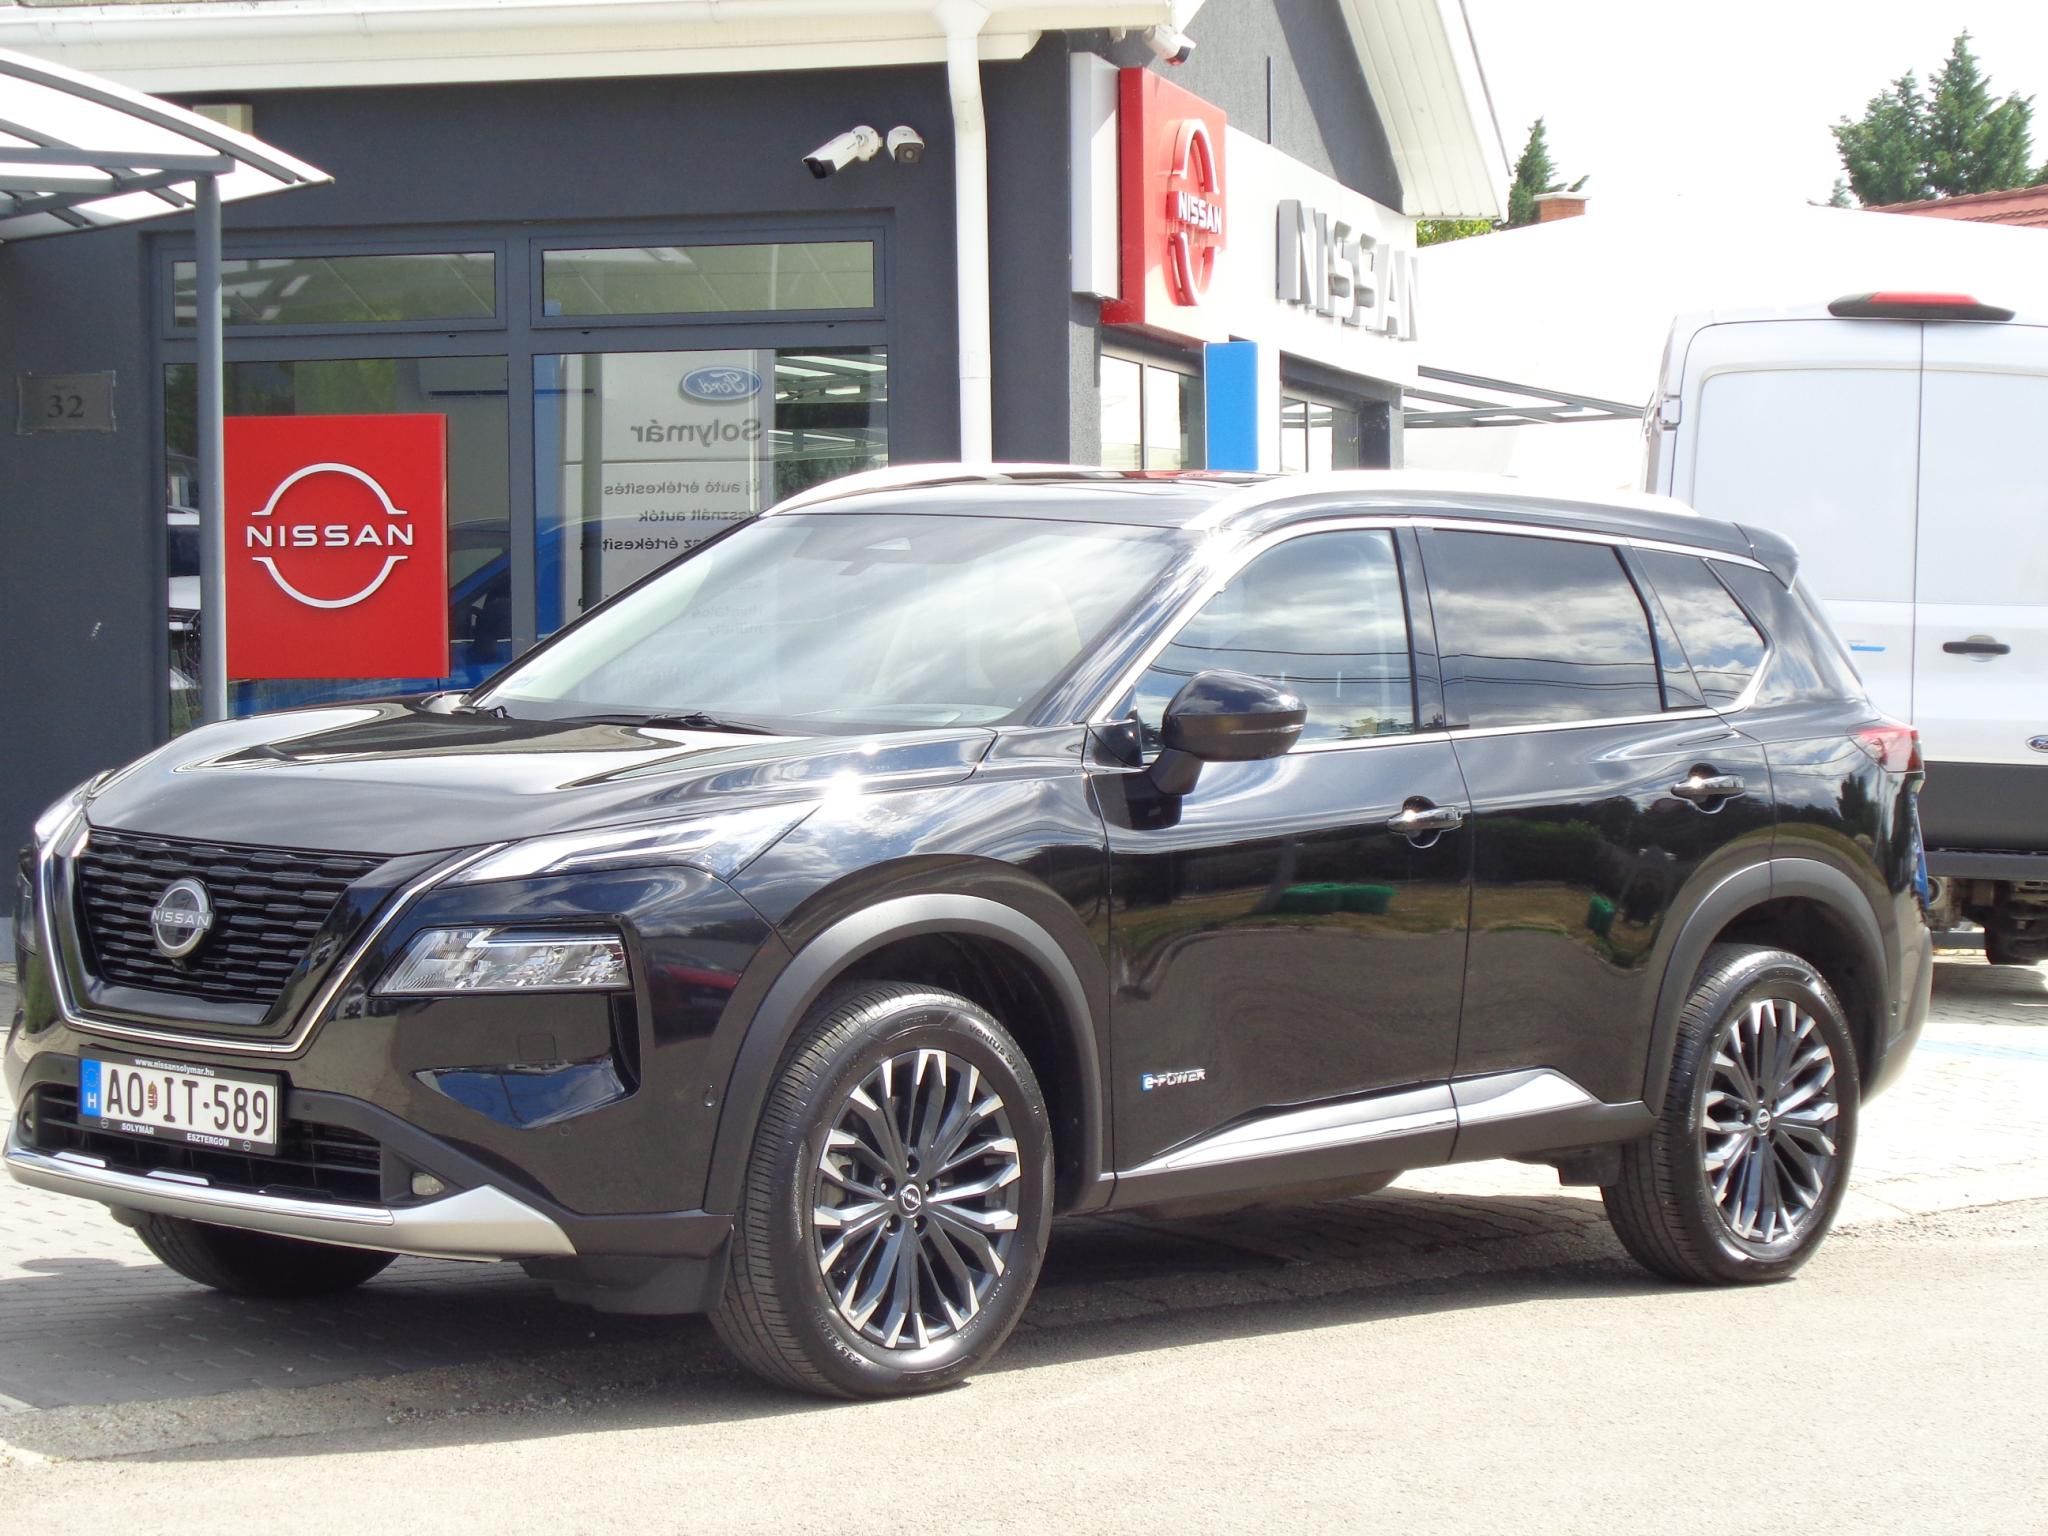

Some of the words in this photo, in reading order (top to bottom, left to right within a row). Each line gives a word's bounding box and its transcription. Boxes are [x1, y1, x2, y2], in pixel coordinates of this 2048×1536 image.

[1176, 191, 1222, 236] NISSAN
[1277, 199, 1418, 342] NISSAN
[47, 395, 85, 418] 32
[247, 523, 414, 547] NISSAN
[151, 909, 210, 927] NISSAN
[134, 1058, 215, 1077] www.nissansolymar.hu
[87, 1093, 97, 1109] H
[106, 1069, 144, 1117] AO
[121, 1122, 155, 1136] SOLYMÁR
[186, 1132, 231, 1148] ESZTERGOM
